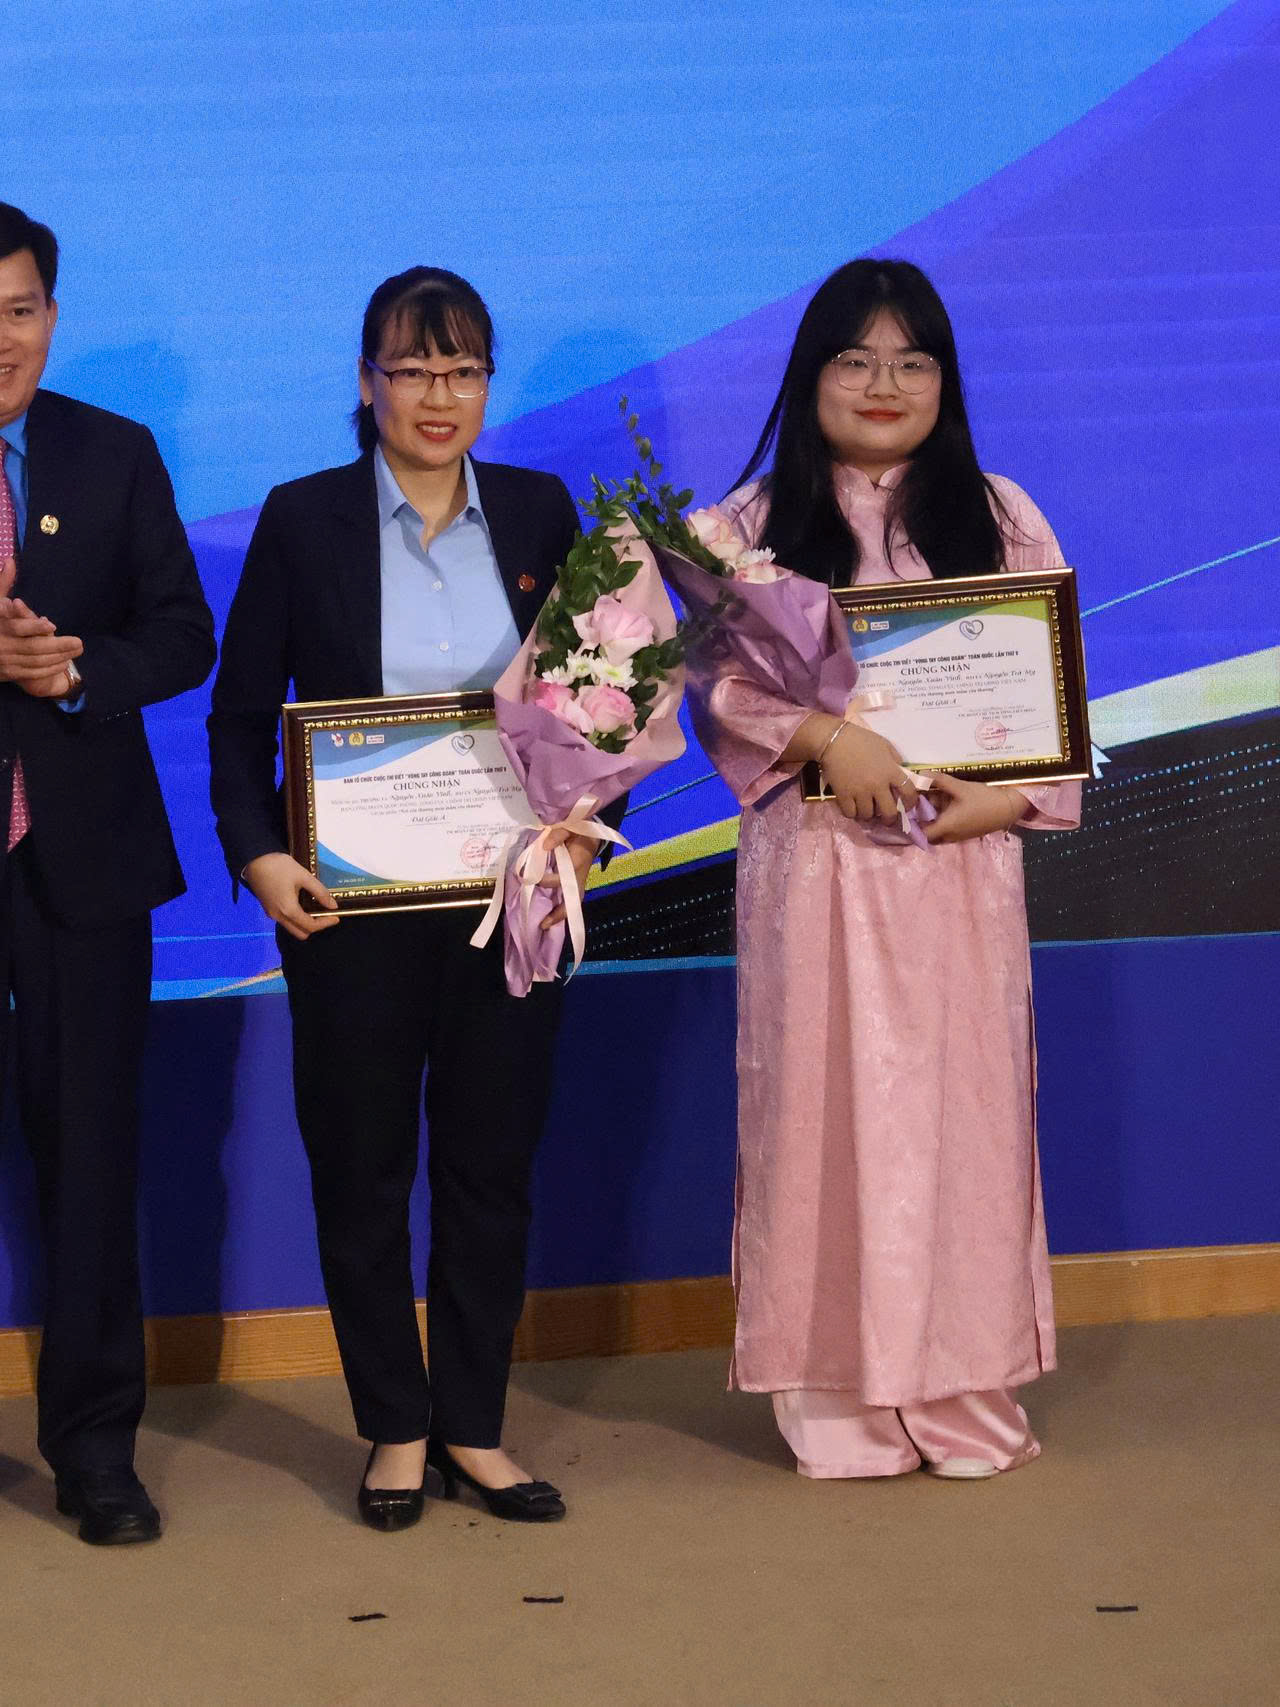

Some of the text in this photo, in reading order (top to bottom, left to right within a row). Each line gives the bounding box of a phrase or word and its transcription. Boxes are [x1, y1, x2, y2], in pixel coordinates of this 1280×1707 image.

[900, 662, 970, 676] CHỨNG NHẬN
[394, 778, 460, 791] CHỨNG NHẬN
